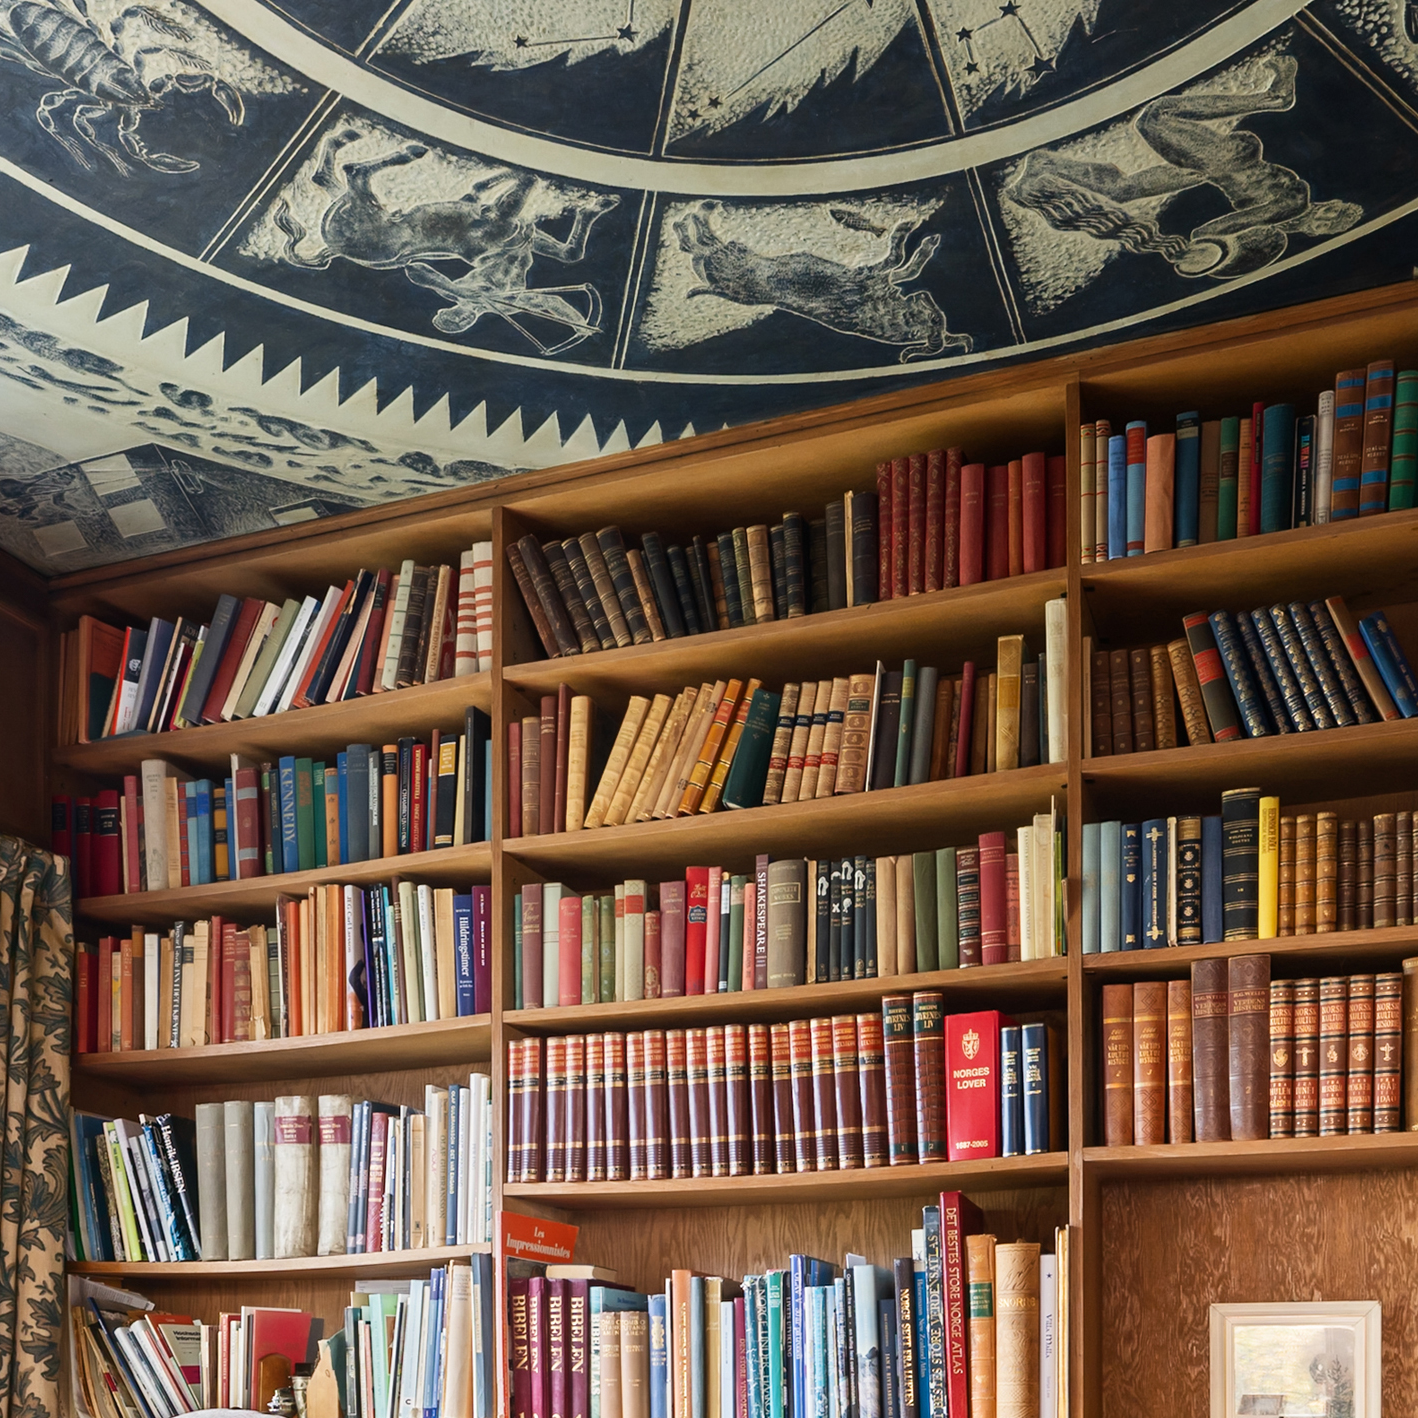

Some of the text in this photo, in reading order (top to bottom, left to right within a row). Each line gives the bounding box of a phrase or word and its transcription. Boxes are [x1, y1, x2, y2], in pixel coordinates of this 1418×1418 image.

[281, 768, 296, 843] KENNEDY
[458, 917, 470, 977] Hildringstimer
[756, 872, 766, 954] SHAKESPEARE
[953, 1067, 990, 1079] NORGES
[956, 1079, 986, 1089] LOVER
[161, 1125, 186, 1194] Henrik IBSEN
[955, 1140, 989, 1150] 1687-2005
[506, 1233, 571, 1259] Impressionnistes
[534, 1227, 545, 1238] Les
[756, 1289, 767, 1326] NORGE
[945, 1208, 963, 1374] DET BESTES STORE NORGE ATLAS
[512, 1294, 529, 1371] BIBELEN
[529, 1295, 539, 1374] BIBELEN
[549, 1296, 563, 1373] BIBELEN
[570, 1296, 584, 1374] BIBELEN
[900, 1288, 915, 1406] NORGE SETT FRA LUFTEN
[916, 1278, 927, 1377] Heinemann New Zealand Atlas
[931, 1329, 943, 1365] STORE
[888, 1407, 893, 1416] OG
